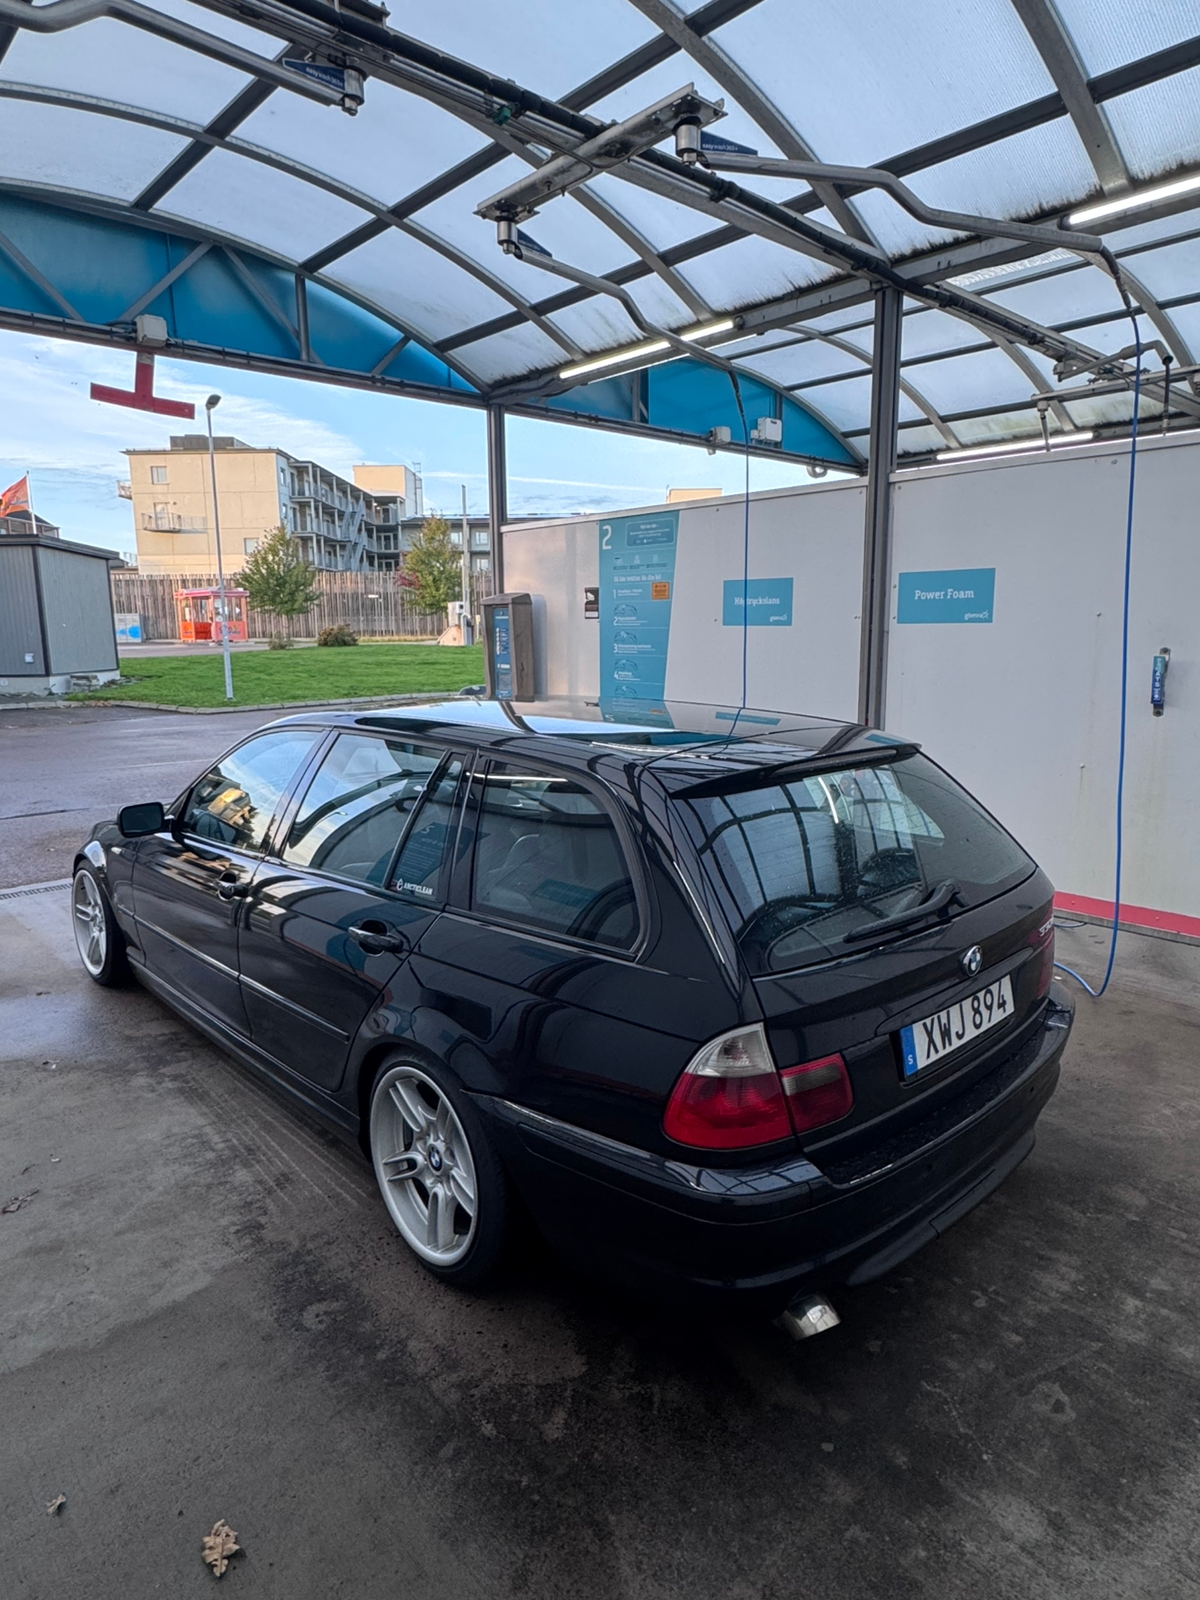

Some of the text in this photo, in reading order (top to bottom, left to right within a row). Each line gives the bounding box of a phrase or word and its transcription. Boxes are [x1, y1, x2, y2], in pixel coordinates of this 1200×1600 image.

[602, 525, 612, 550] 2
[914, 588, 974, 600] Power Foam
[922, 980, 1007, 1060] XWJ 894
[907, 1054, 914, 1065] S
